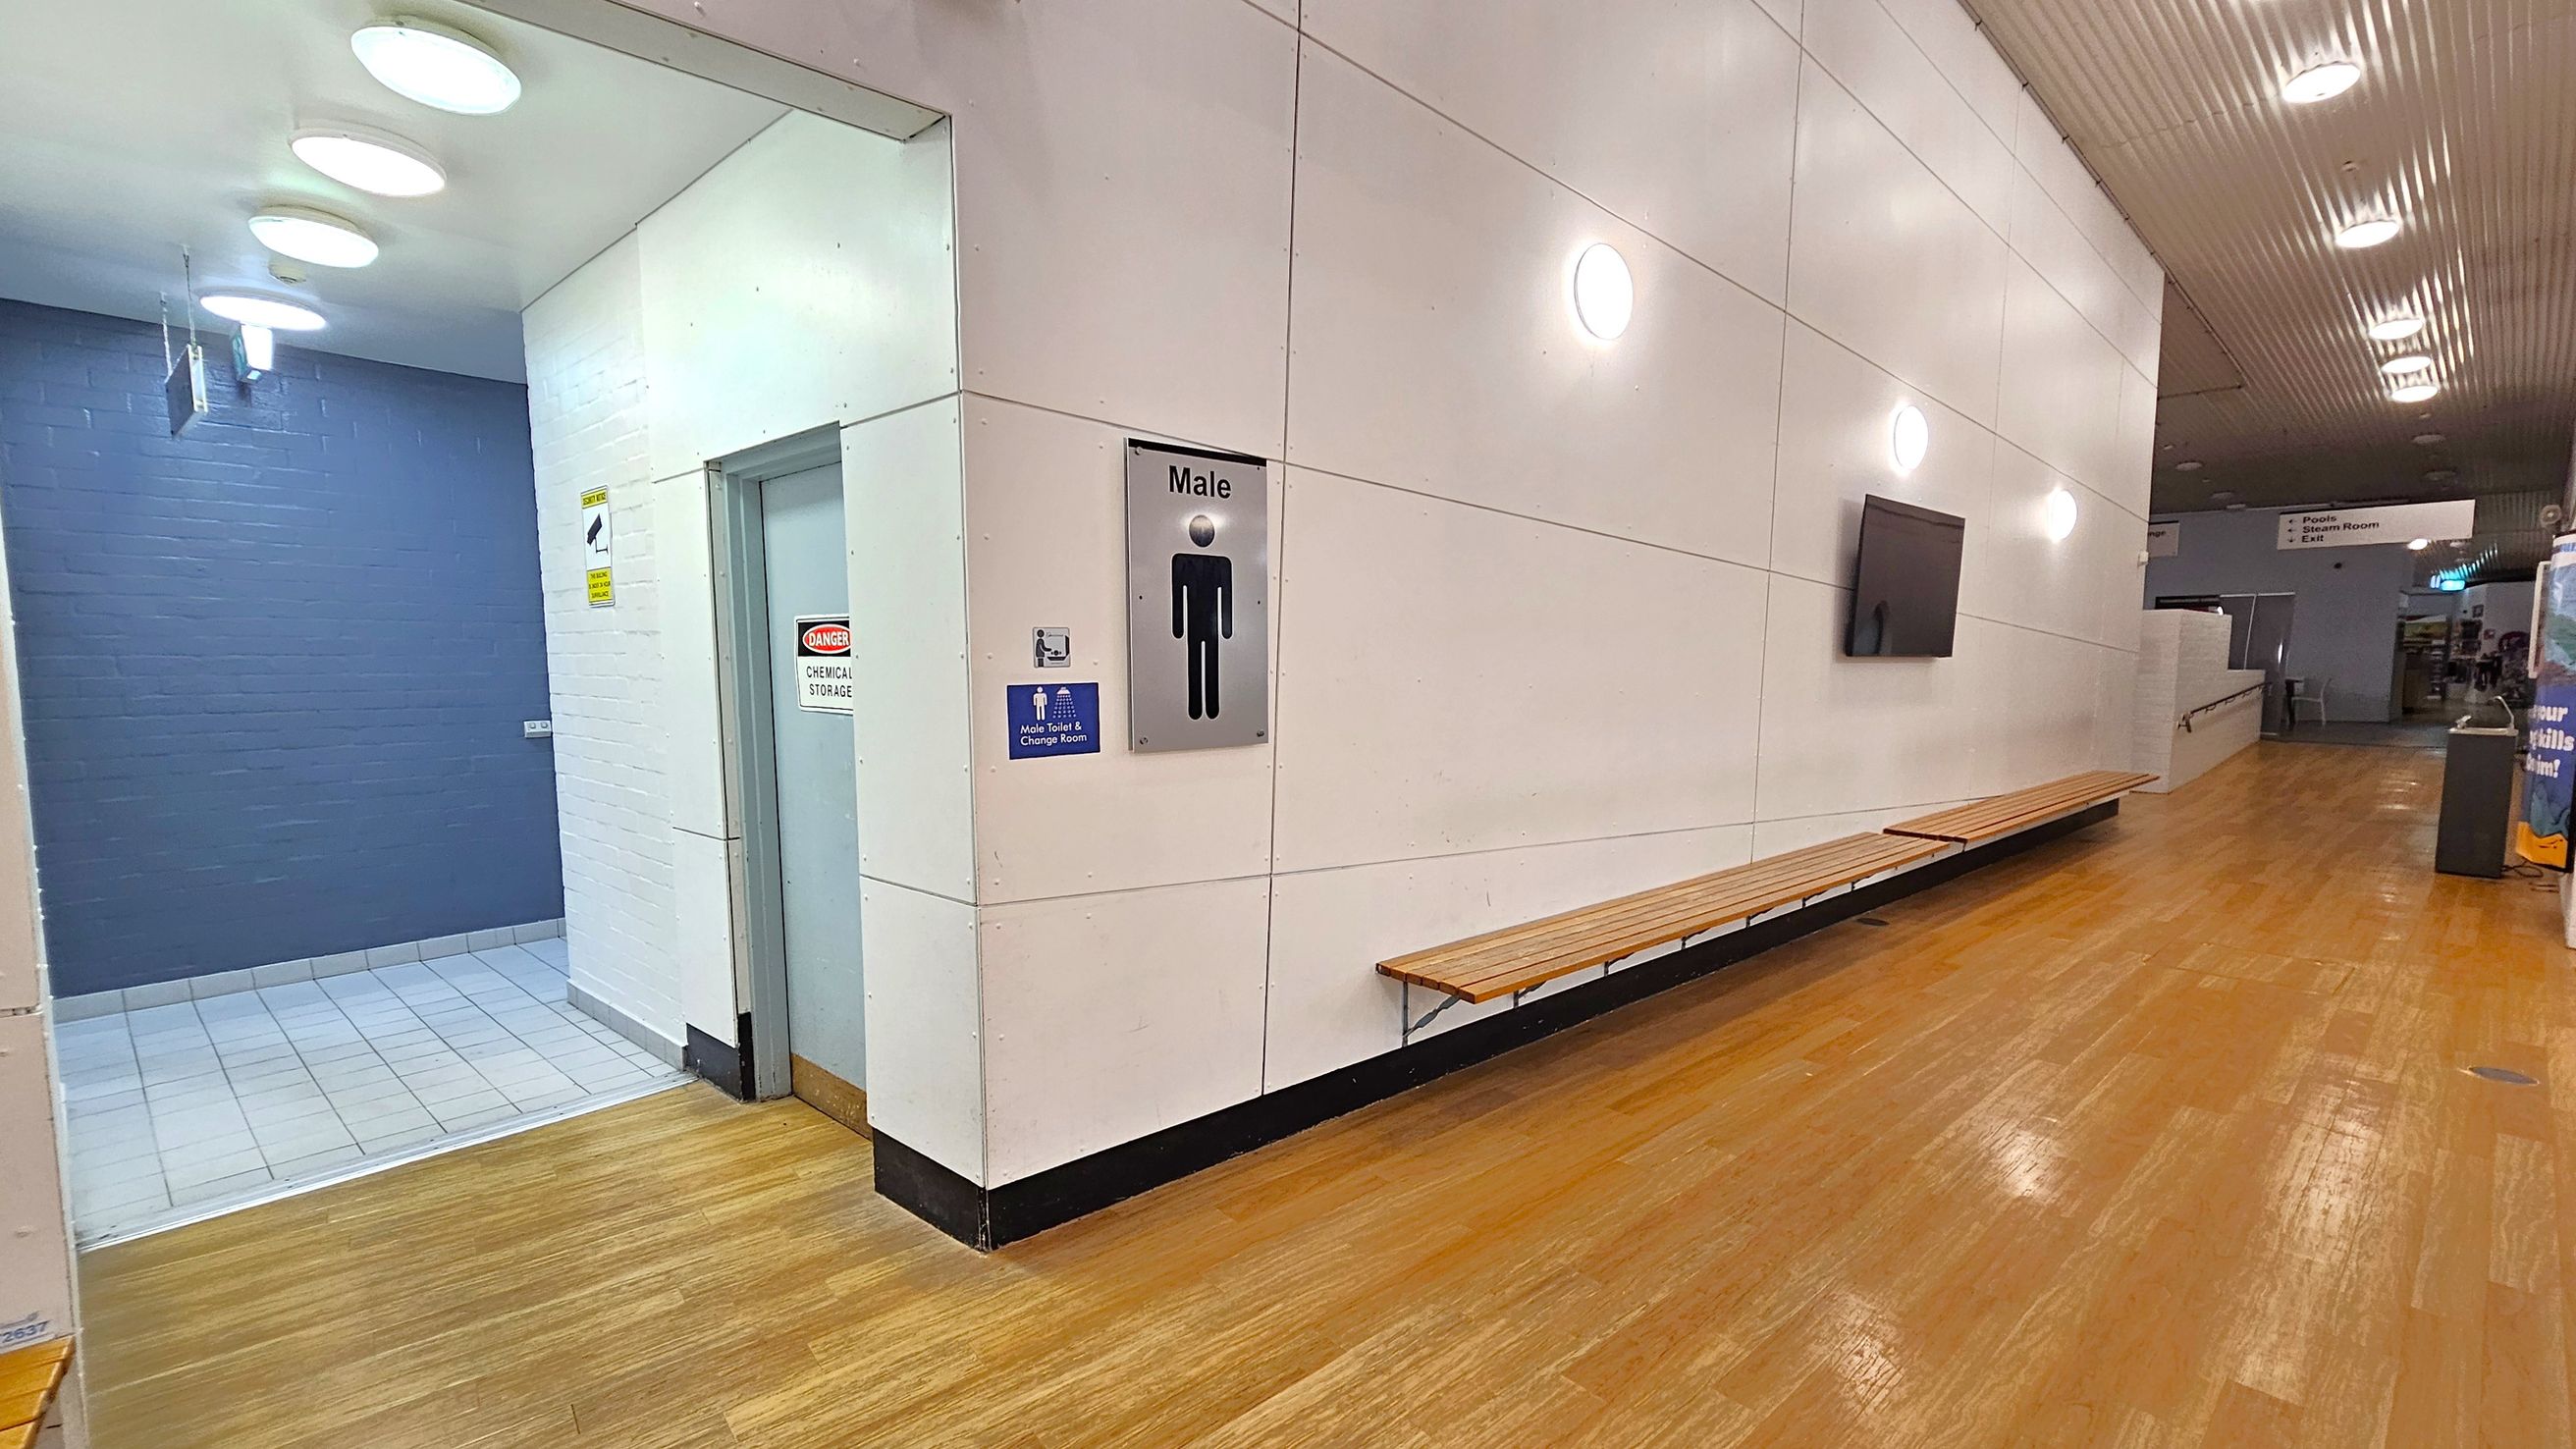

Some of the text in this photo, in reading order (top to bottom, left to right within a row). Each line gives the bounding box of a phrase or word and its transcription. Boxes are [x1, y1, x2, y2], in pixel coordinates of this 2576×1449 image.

[1168, 464, 1232, 500] Male
[2302, 514, 2337, 524] Pools
[2302, 521, 2380, 534] Steam Room
[2301, 534, 2324, 543] Exit
[808, 630, 849, 647] DANGER
[806, 666, 852, 679] CHEMICAL
[809, 683, 852, 698] STORAGE
[1020, 721, 1083, 734] Male Toilet &
[1020, 733, 1088, 746] Change Room
[0, 1320, 49, 1344] 2637
